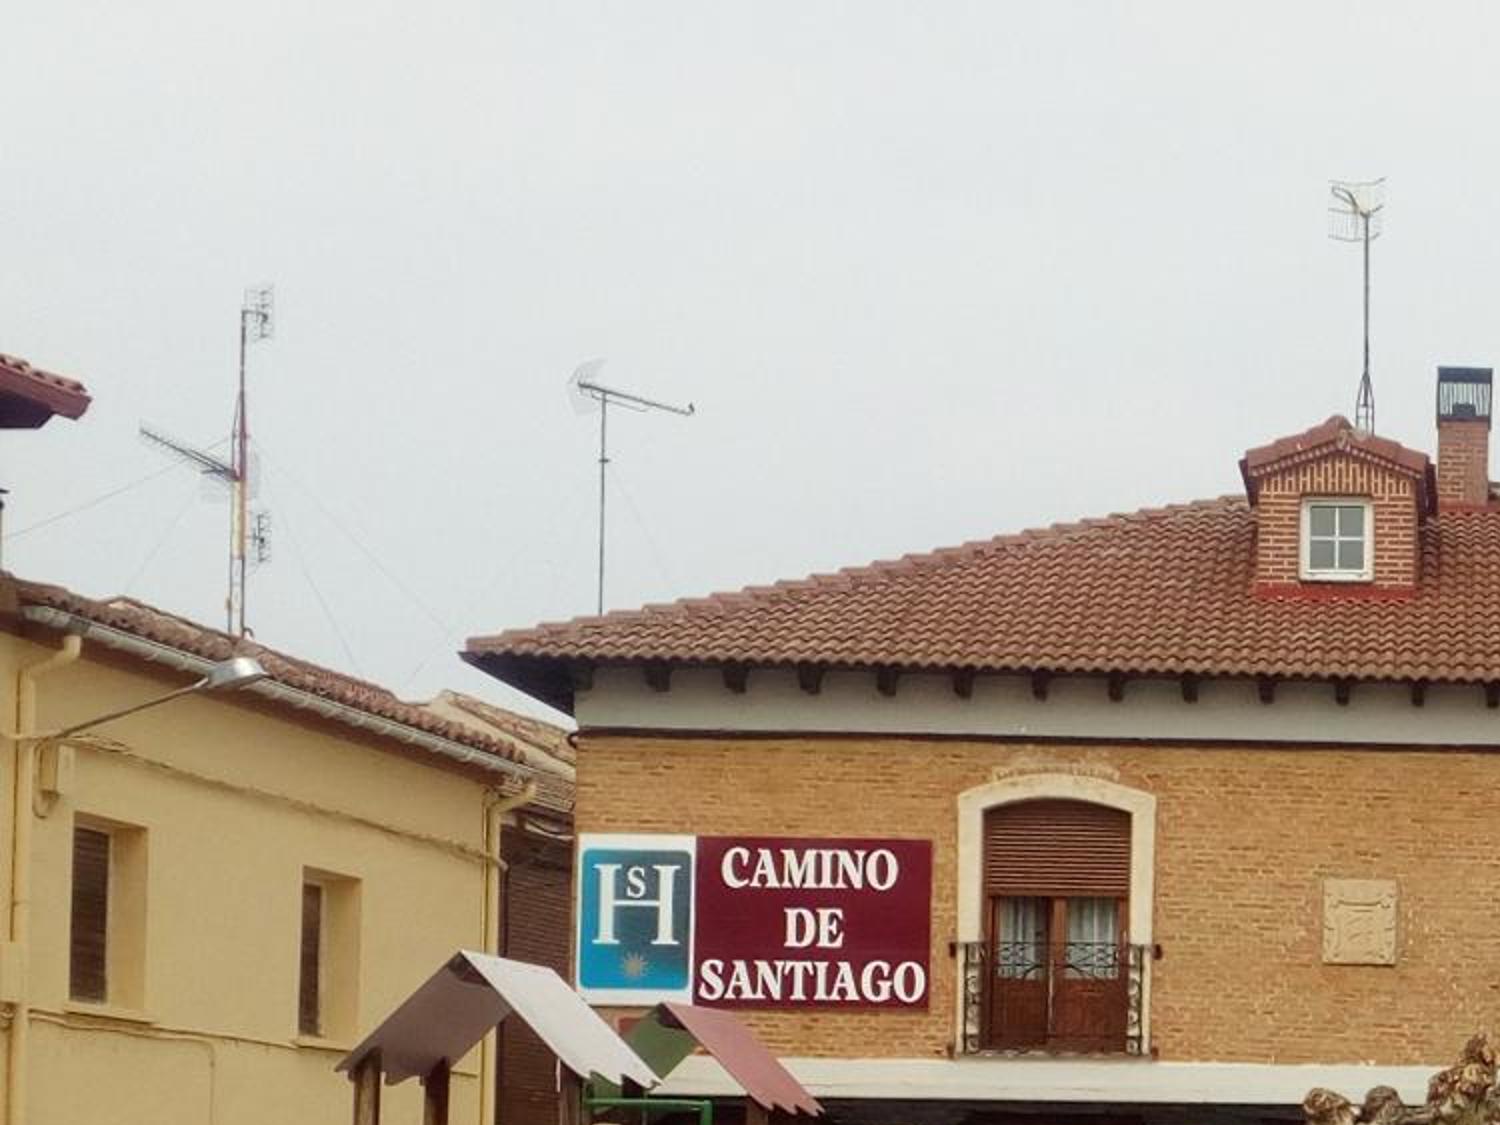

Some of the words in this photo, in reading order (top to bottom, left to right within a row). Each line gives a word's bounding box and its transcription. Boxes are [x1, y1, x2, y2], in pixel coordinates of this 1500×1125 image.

[721, 846, 899, 890] CAMINO
[784, 908, 844, 948] DE
[700, 959, 926, 1003] SANTIAGO
